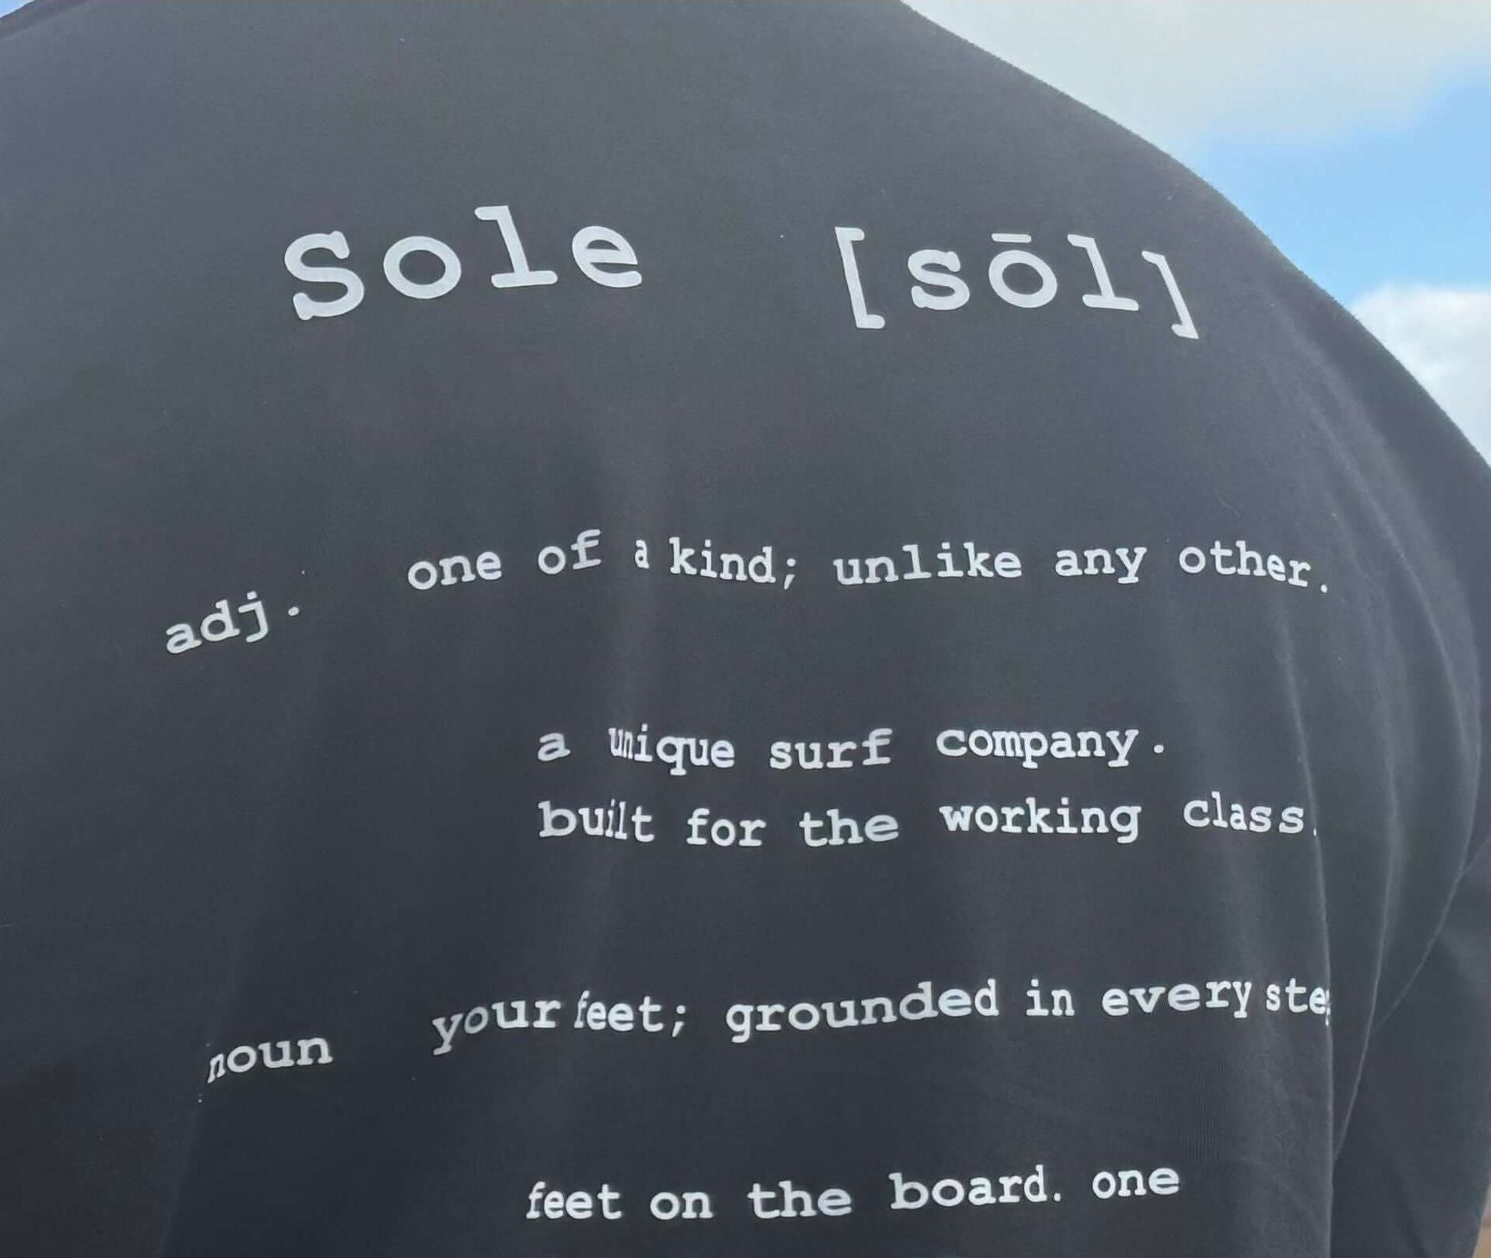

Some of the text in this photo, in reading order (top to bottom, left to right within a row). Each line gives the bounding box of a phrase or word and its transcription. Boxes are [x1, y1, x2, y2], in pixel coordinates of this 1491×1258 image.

[284, 204, 1200, 340] Sole [sōl]
[165, 528, 1328, 654] adj. one of a kind; unlike any other.
[537, 723, 1165, 777] a unique surf company.
[537, 798, 655, 843] built
[686, 807, 767, 847] for
[798, 808, 900, 848] the
[938, 796, 1143, 844] working
[207, 977, 1332, 1084] noun your feet; grounded in every ste
[525, 1163, 1180, 1221] feet on the board. one
